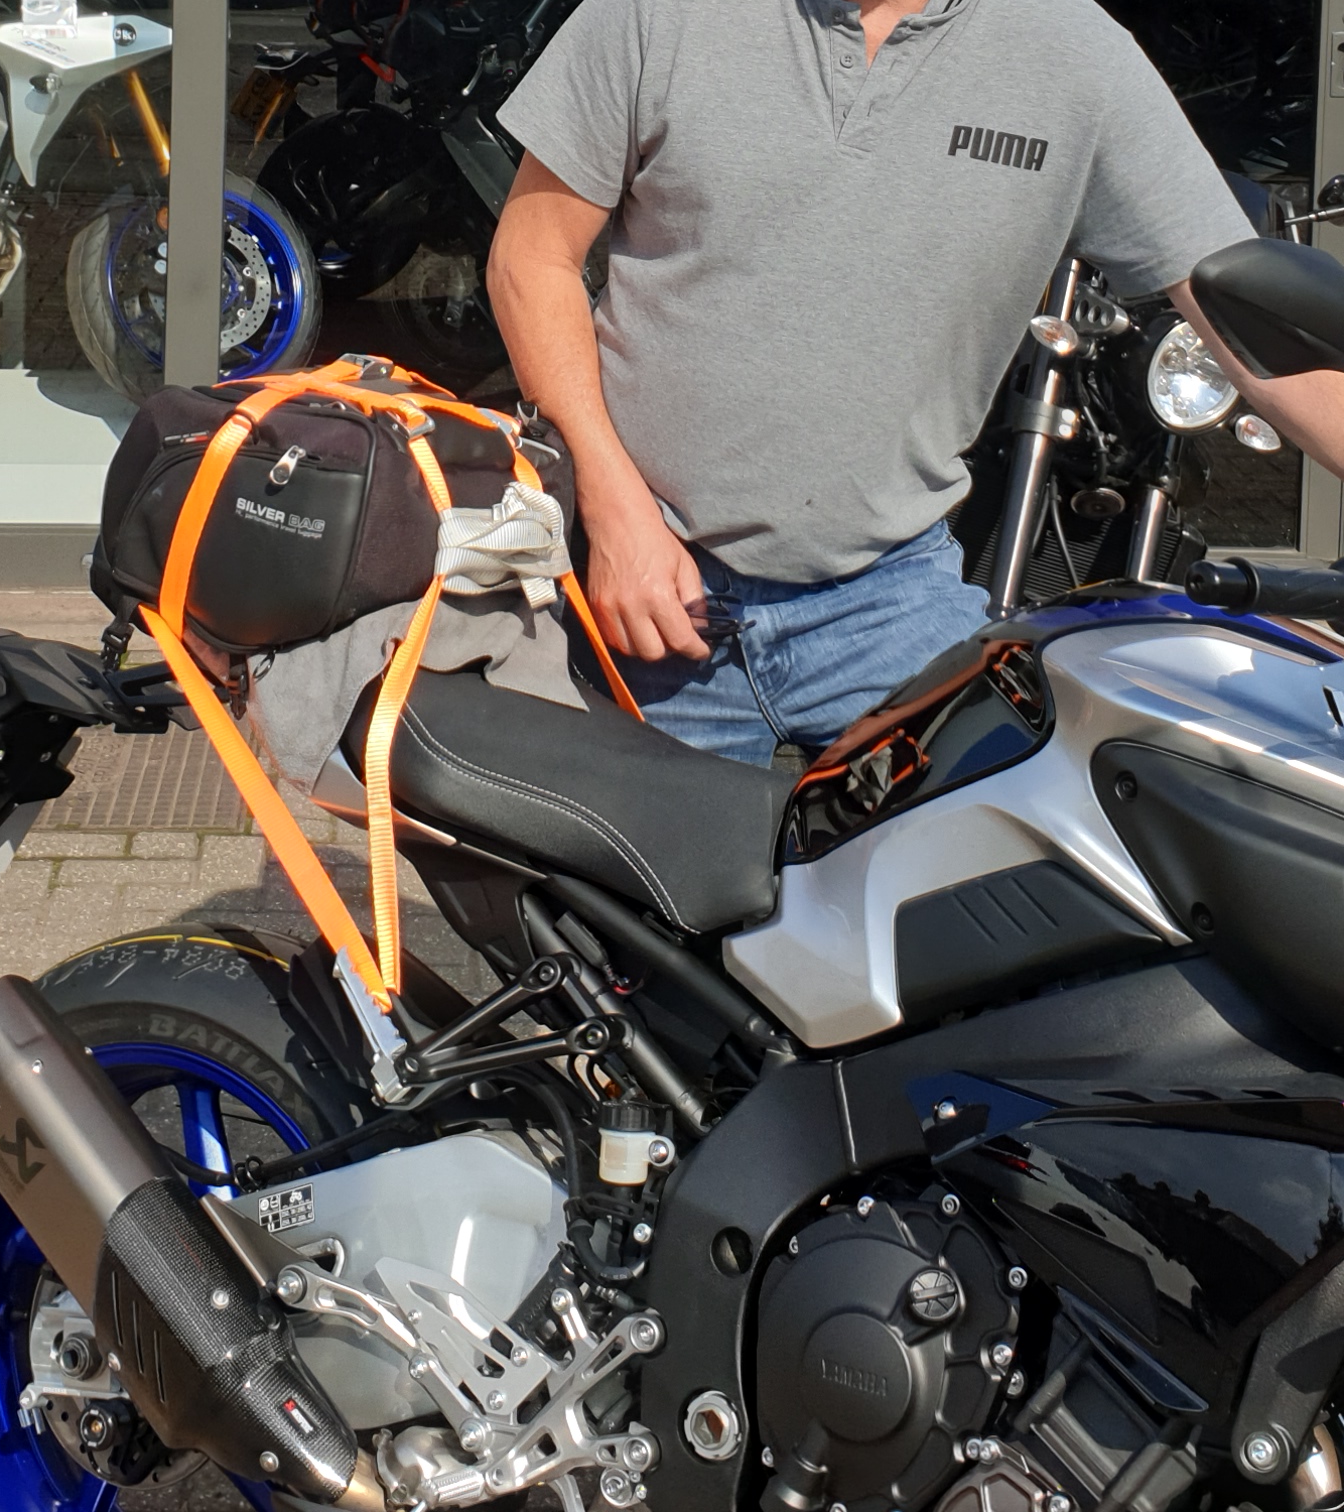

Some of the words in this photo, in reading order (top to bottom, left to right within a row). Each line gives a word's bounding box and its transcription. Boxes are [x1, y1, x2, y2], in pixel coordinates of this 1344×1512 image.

[947, 124, 1049, 172] PUMA
[236, 497, 285, 523] SILVER
[288, 513, 325, 532] BAG
[148, 1013, 314, 1124] BATTLAX
[820, 1358, 888, 1398] YAMAHA
